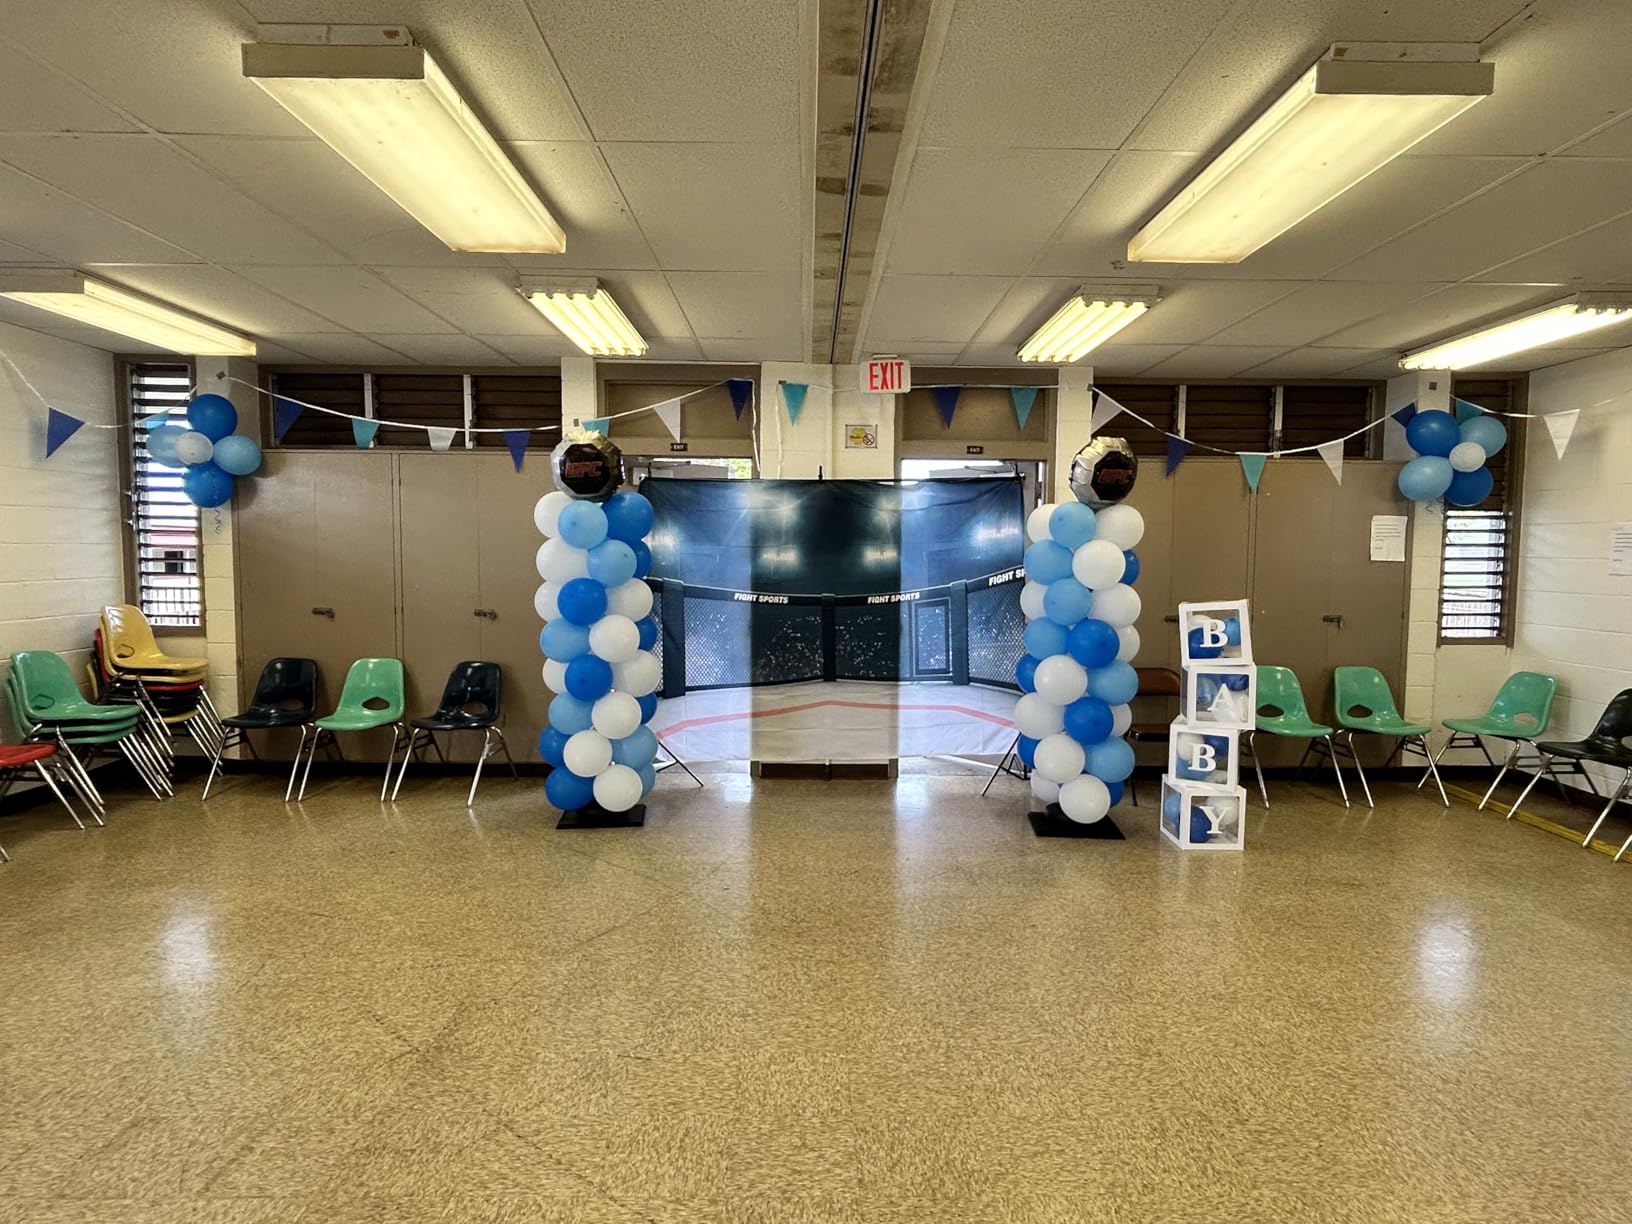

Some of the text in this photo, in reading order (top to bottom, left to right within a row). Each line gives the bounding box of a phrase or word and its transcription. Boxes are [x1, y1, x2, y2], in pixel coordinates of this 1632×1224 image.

[869, 362, 904, 390] EXIT
[989, 570, 1014, 586] FIGHT
[734, 592, 789, 604] FIGHT SPORTS
[867, 592, 920, 604] FIGHT SPORTS
